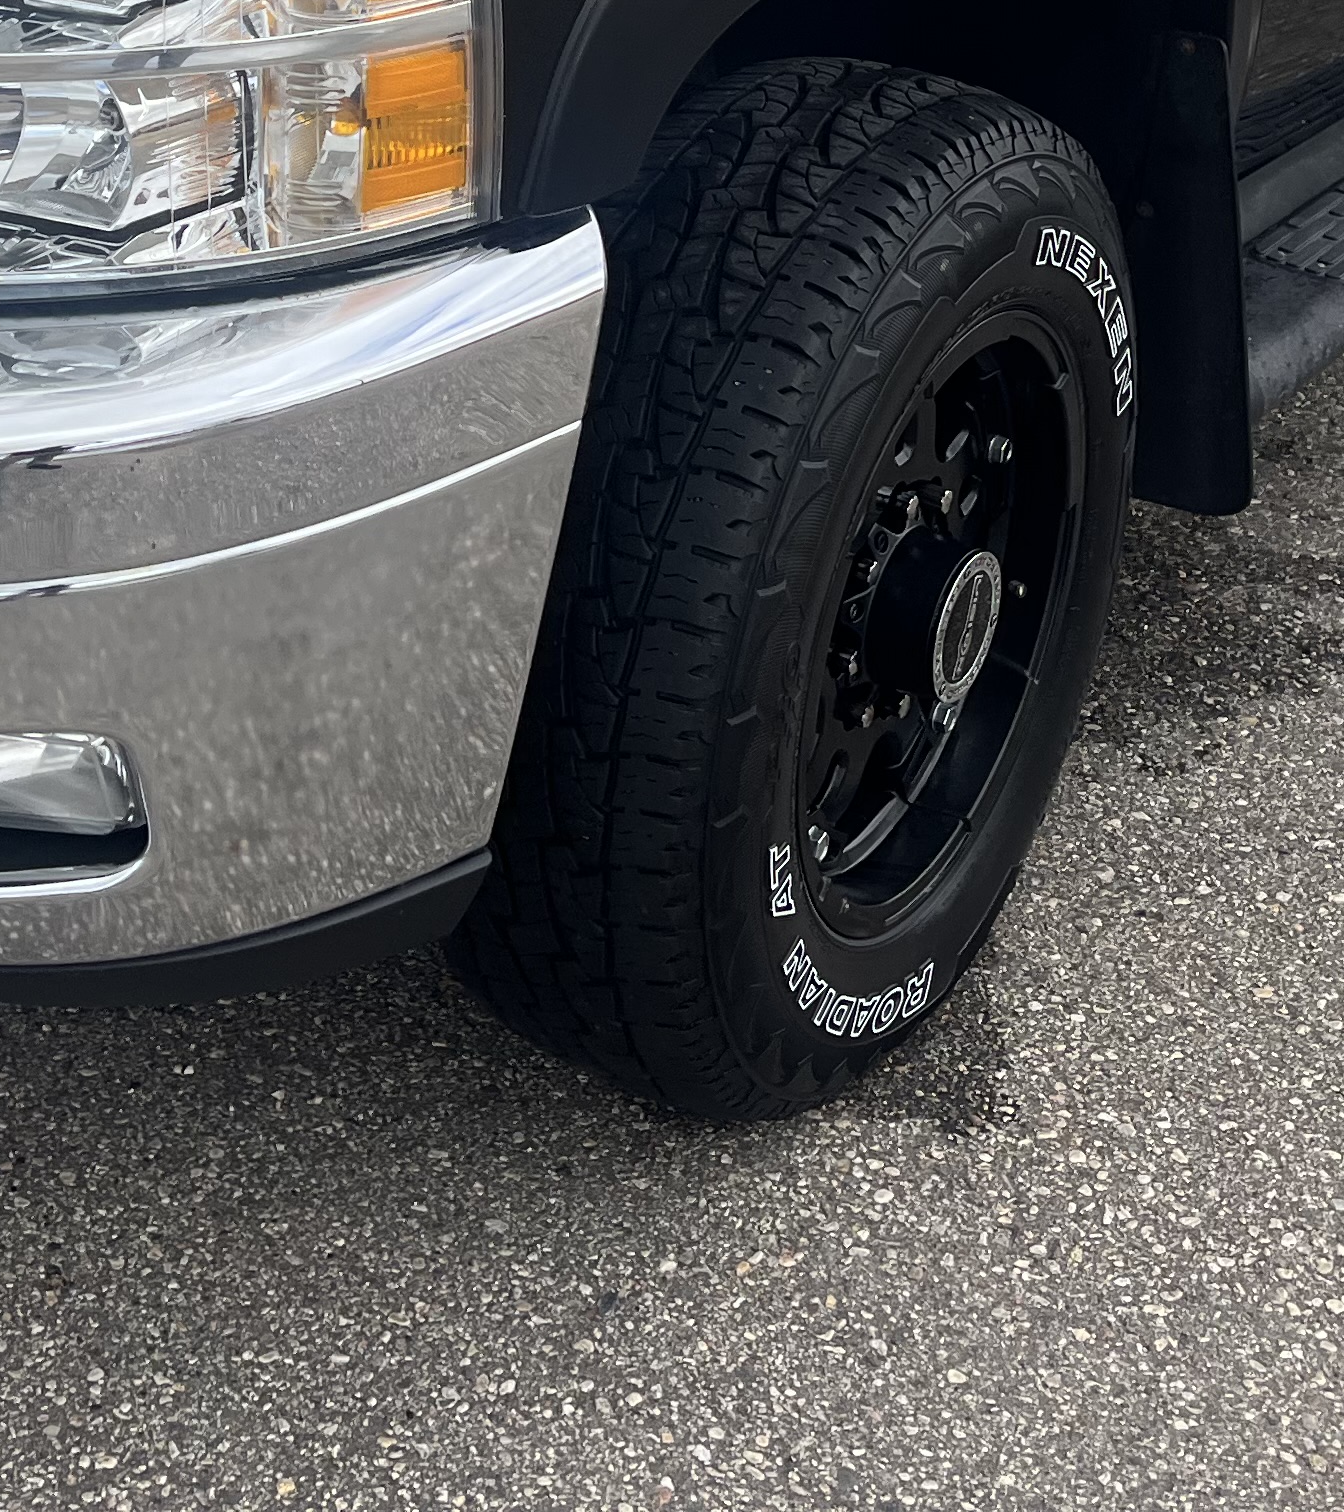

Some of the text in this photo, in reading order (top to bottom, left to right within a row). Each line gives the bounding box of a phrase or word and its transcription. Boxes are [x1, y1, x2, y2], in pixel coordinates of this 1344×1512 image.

[1035, 227, 1134, 417] NEXEN
[769, 844, 935, 1038] ROADIAN AT
